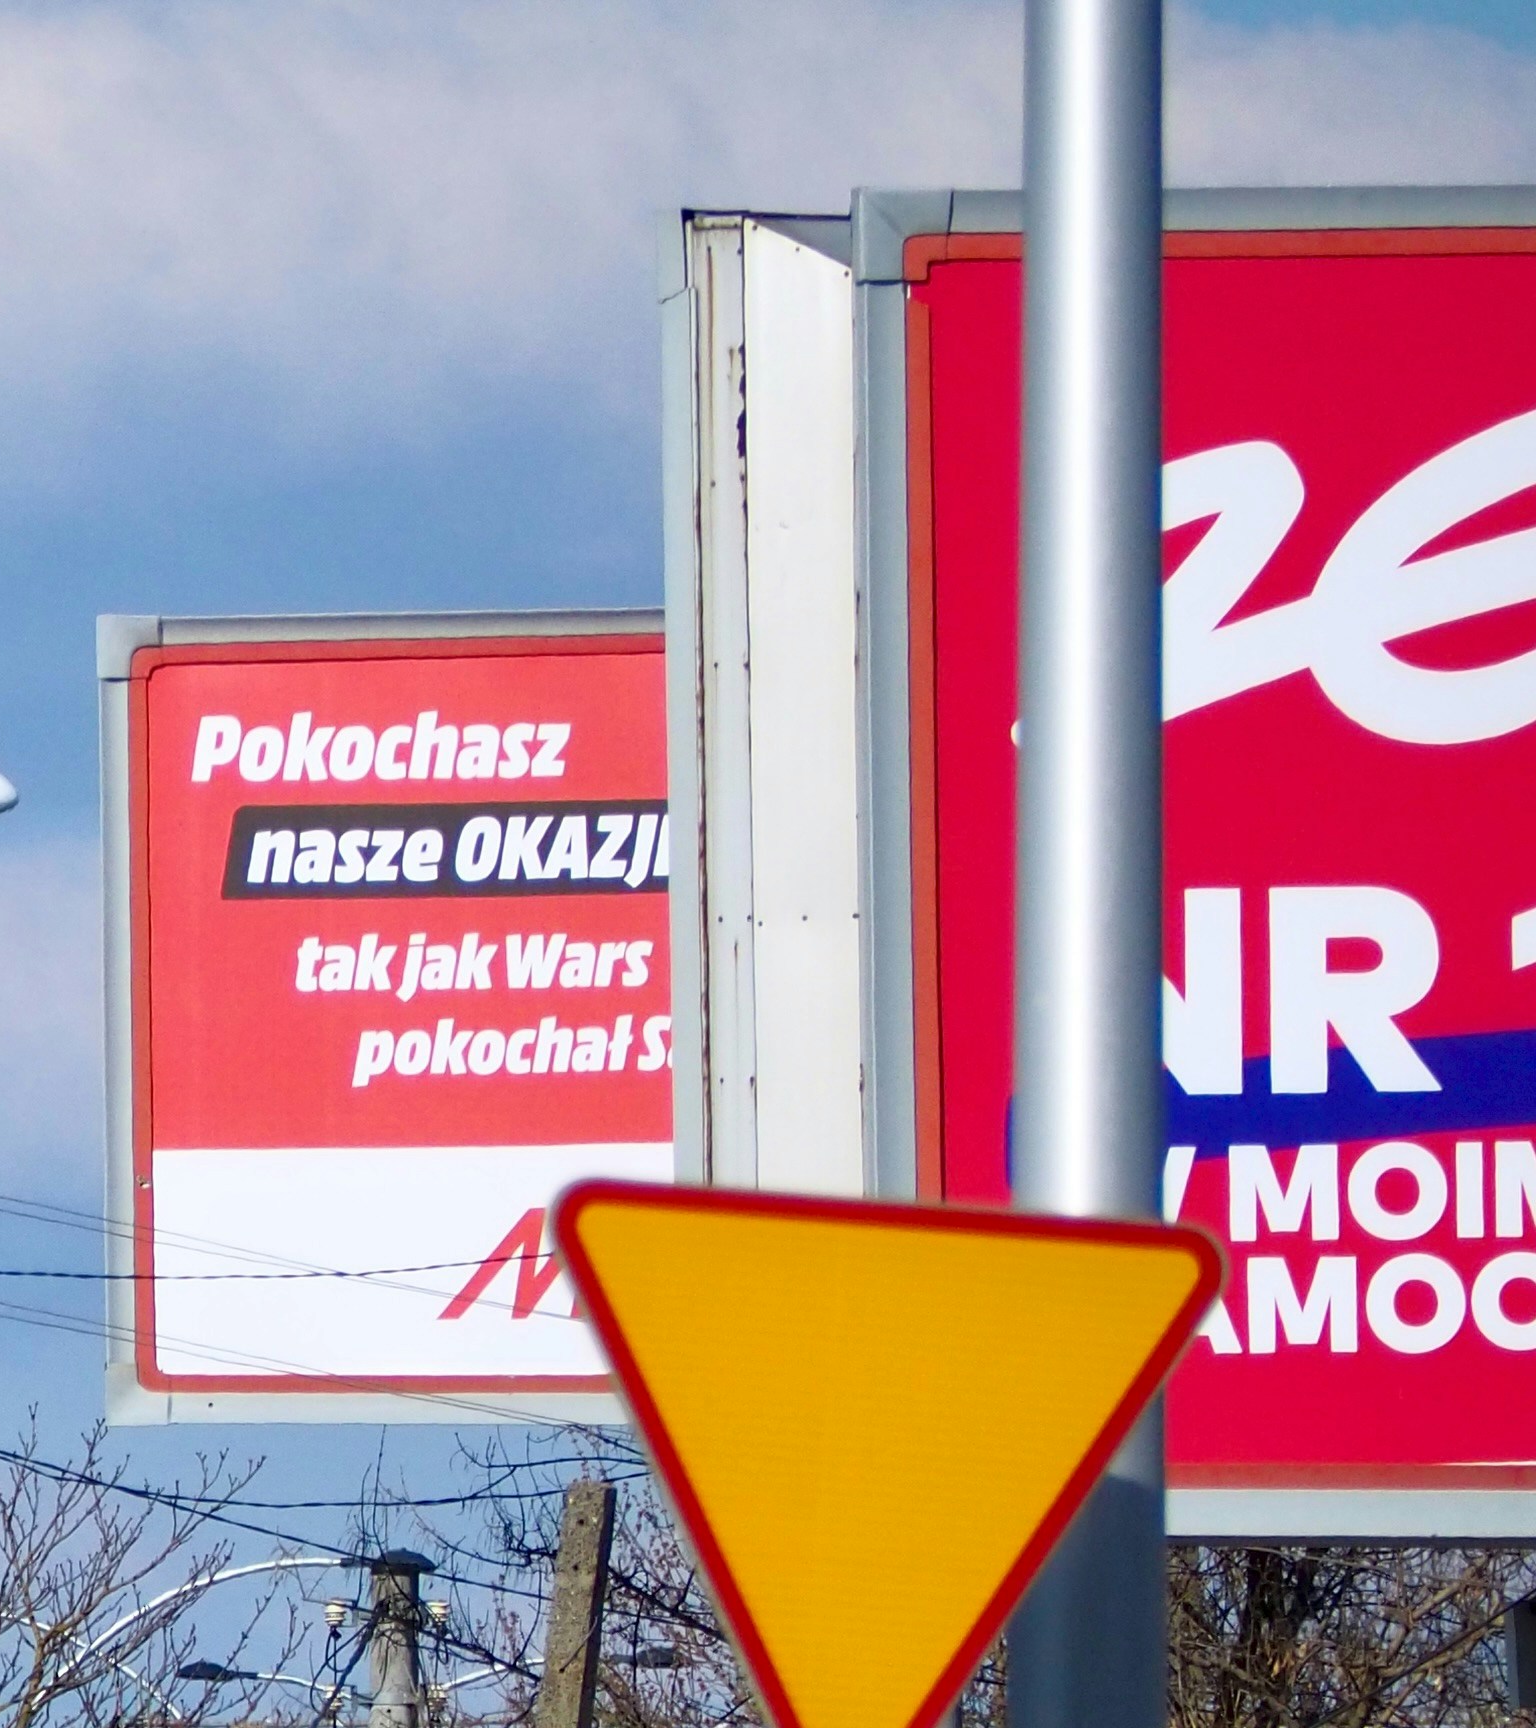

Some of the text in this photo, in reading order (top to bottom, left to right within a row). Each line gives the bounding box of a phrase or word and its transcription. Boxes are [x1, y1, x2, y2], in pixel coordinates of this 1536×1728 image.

[191, 711, 571, 783] Pokochasz
[247, 827, 444, 883] nasze
[294, 932, 653, 1002] tak jak Wars
[351, 1014, 673, 1087] pokochał S
